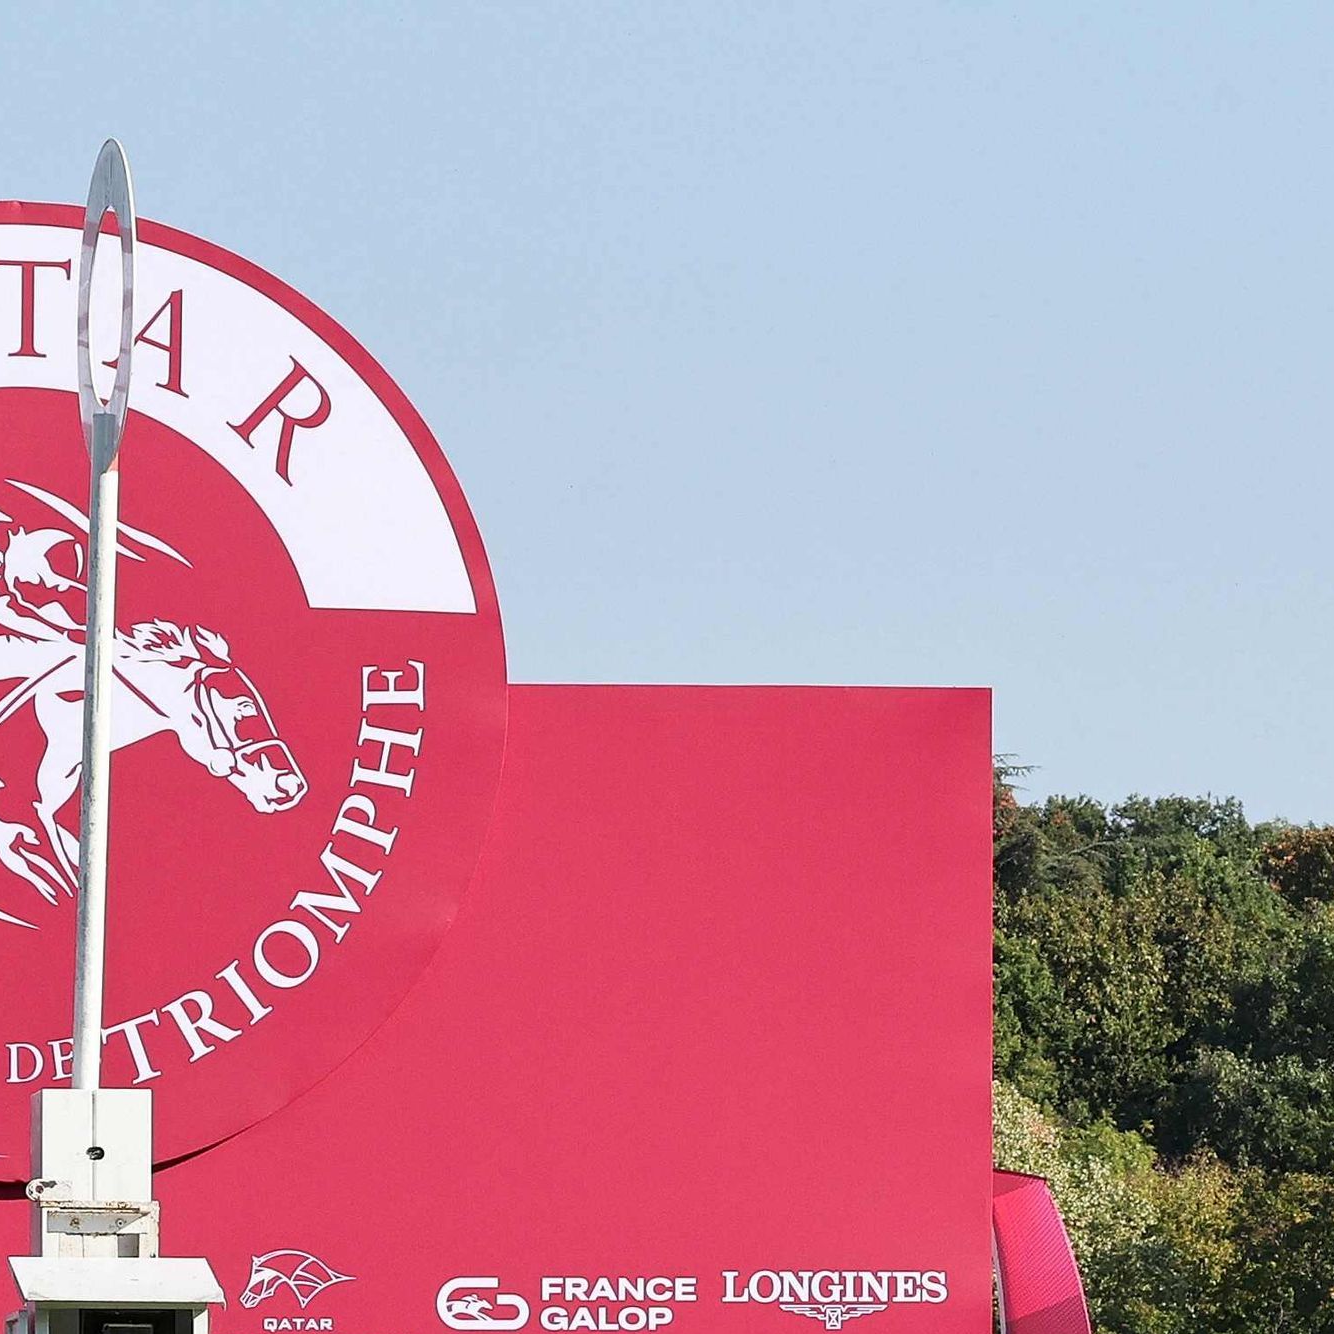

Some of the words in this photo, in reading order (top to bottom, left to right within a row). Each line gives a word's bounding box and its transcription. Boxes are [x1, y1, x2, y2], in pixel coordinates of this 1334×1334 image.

[5, 1041, 73, 1084] DE
[101, 657, 426, 1086] TRIOMPHE
[541, 1276, 697, 1302] FRANCE
[722, 1270, 948, 1304] LONGINES
[263, 1317, 333, 1332] QATAR
[540, 1306, 673, 1331] GALOP
